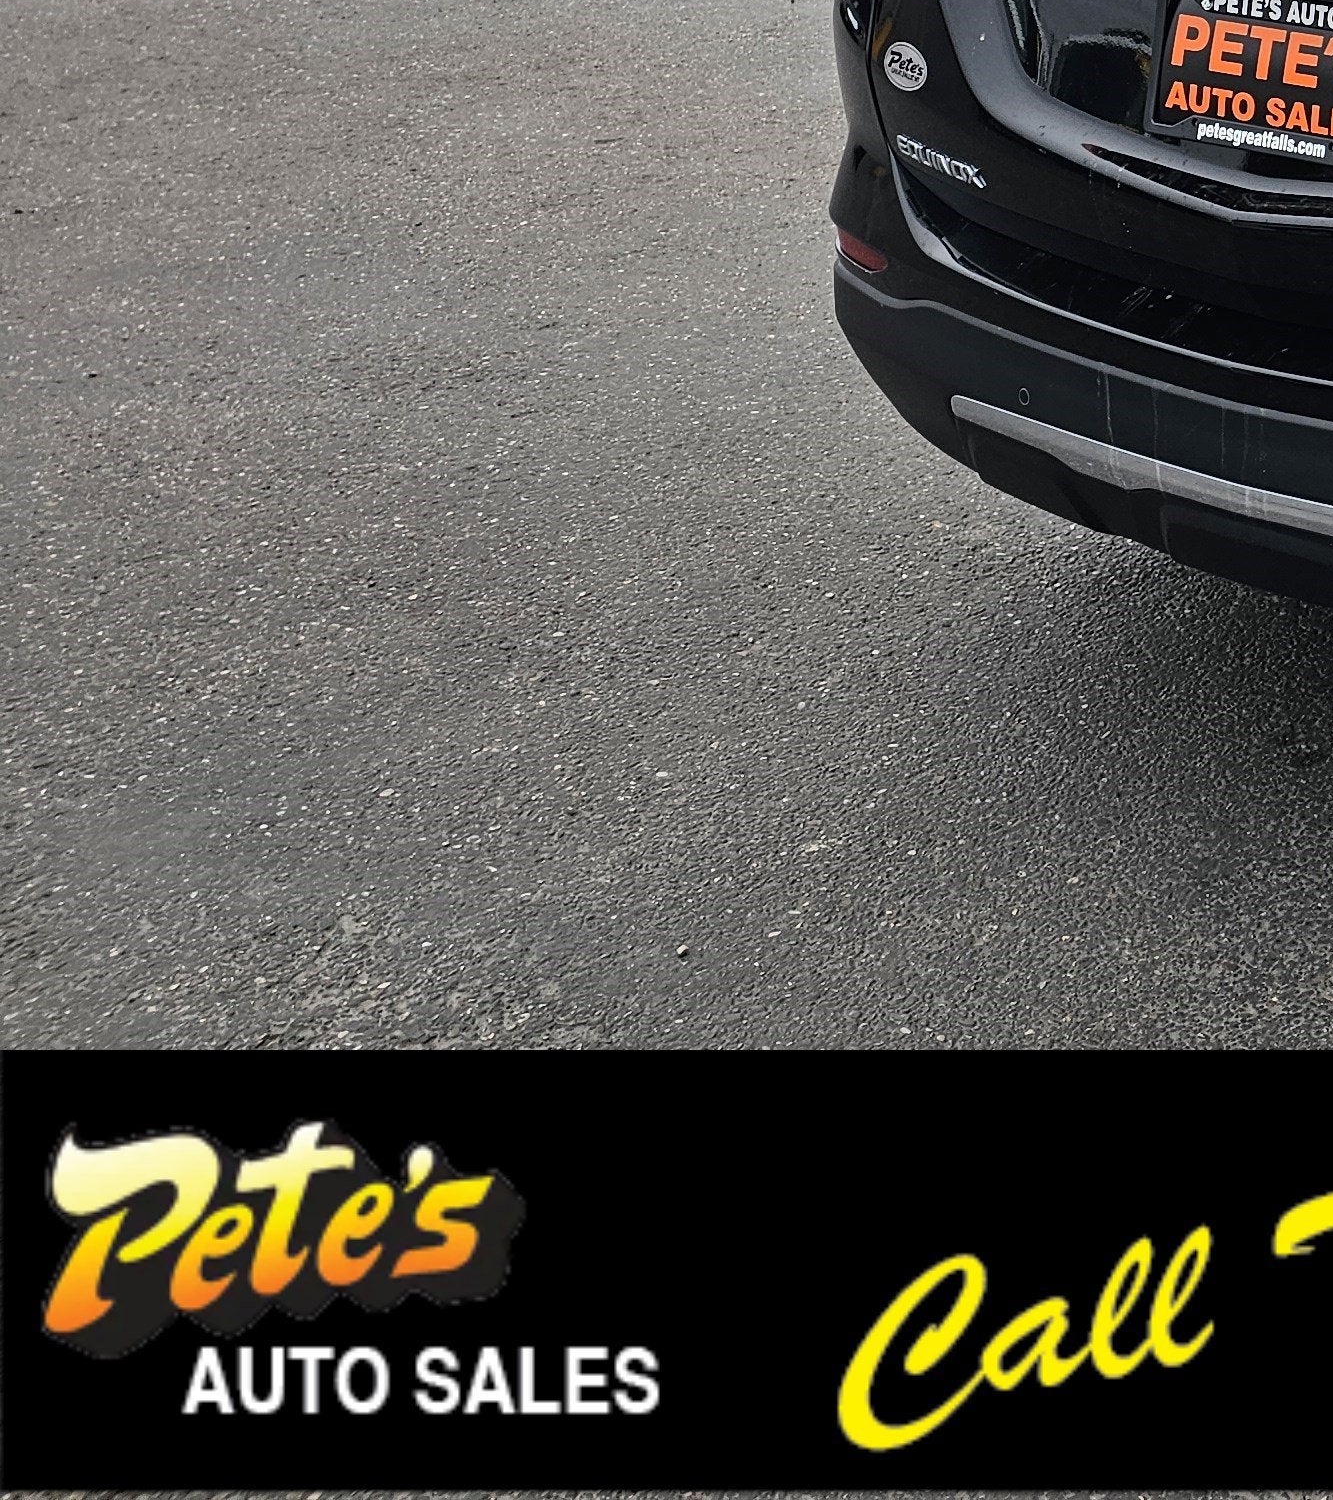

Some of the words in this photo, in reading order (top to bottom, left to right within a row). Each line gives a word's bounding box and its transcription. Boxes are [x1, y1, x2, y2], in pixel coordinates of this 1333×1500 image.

[1165, 81, 1256, 122] AUTO
[1197, 122, 1326, 159] petesgreatfalls.com
[896, 134, 987, 189] EQUINOX
